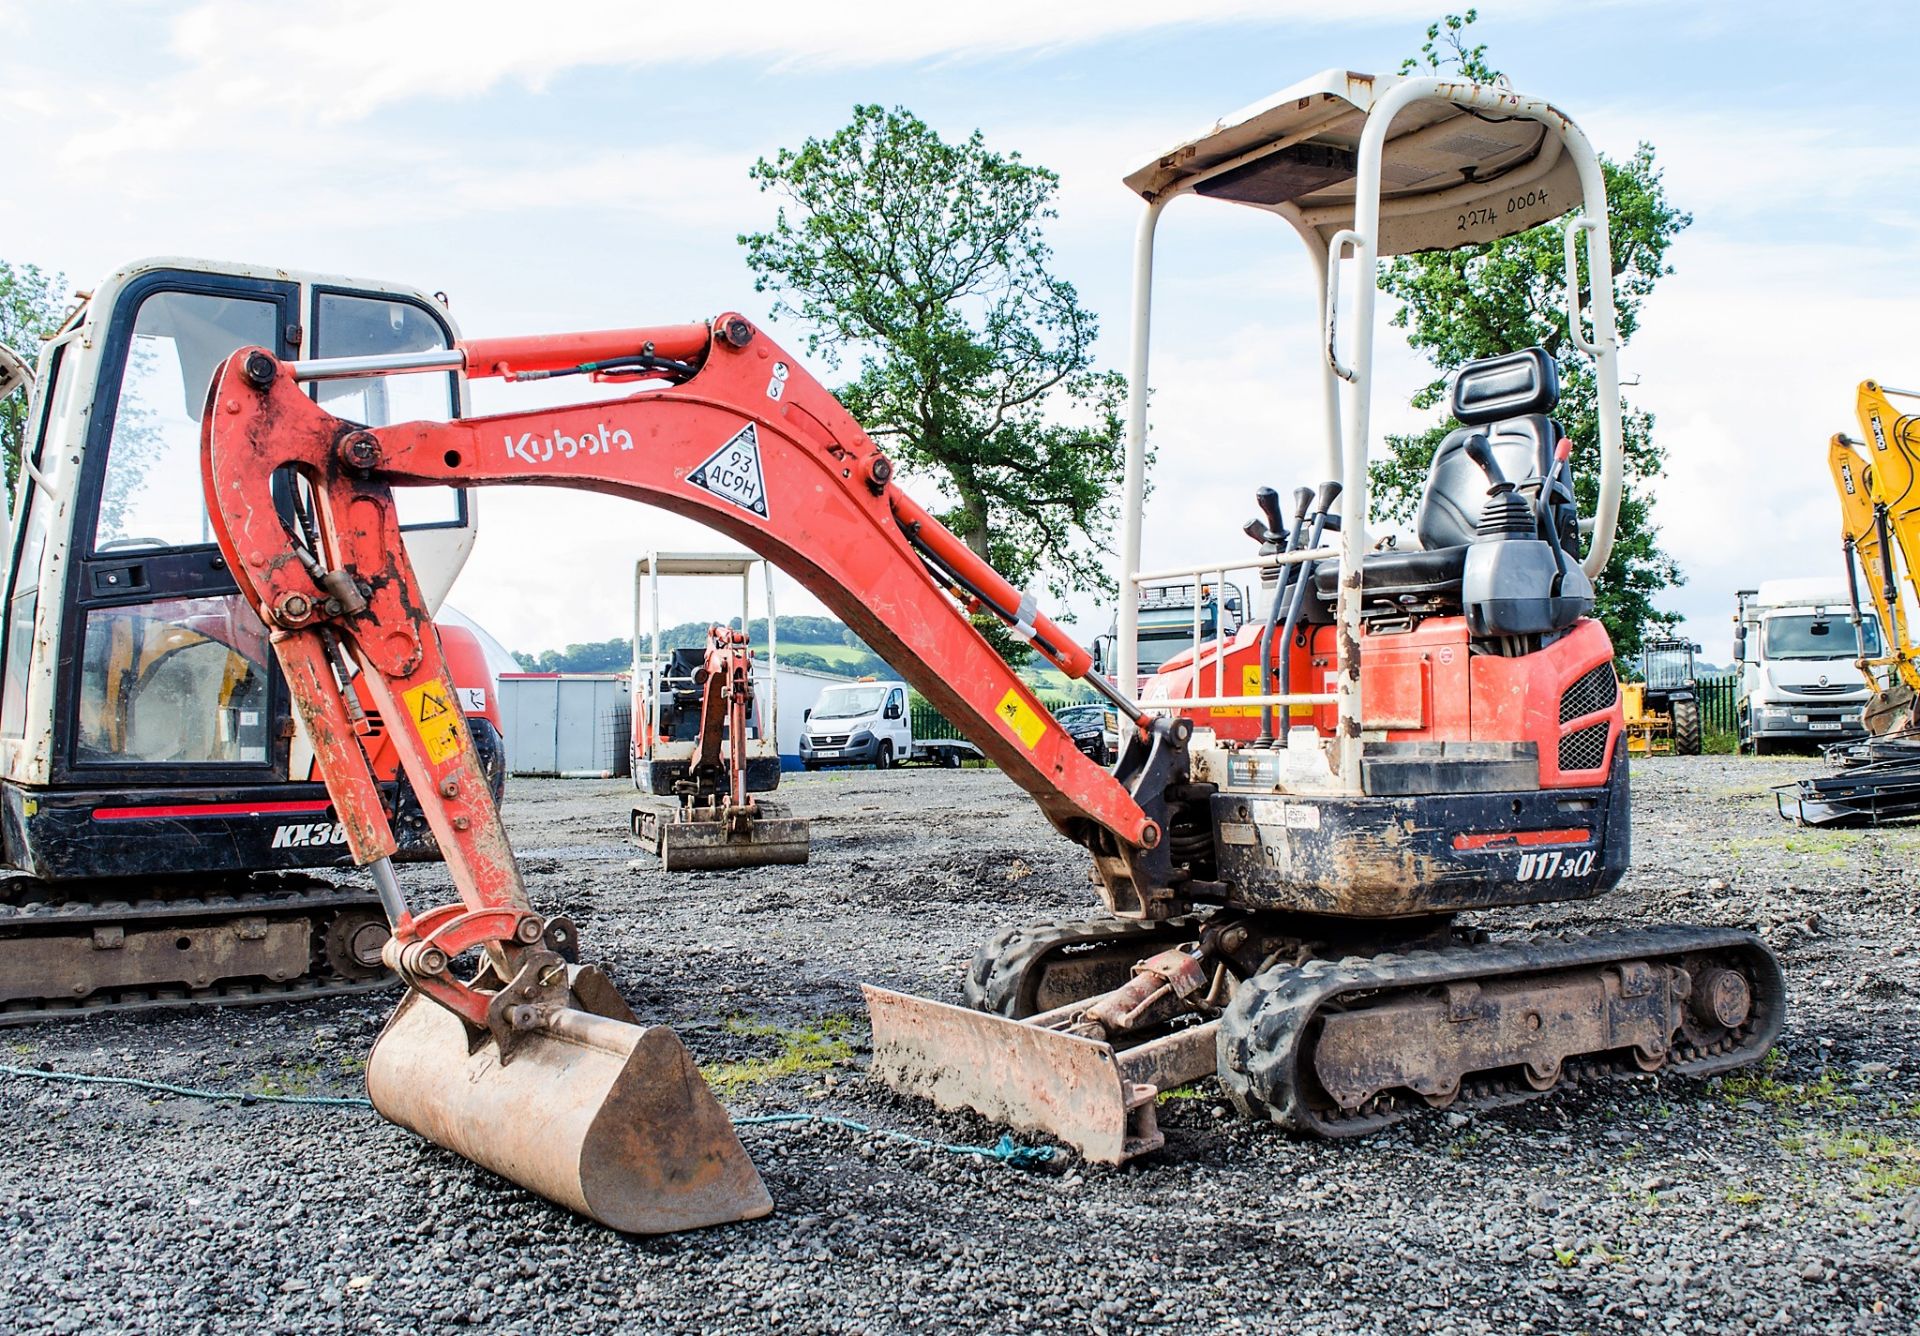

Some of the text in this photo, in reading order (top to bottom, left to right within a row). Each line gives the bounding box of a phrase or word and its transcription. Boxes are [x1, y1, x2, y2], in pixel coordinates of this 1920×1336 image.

[1457, 189, 1548, 231] 2274 0004
[504, 423, 634, 464] Kubota
[730, 451, 752, 474] 93
[710, 465, 756, 499] AC9H
